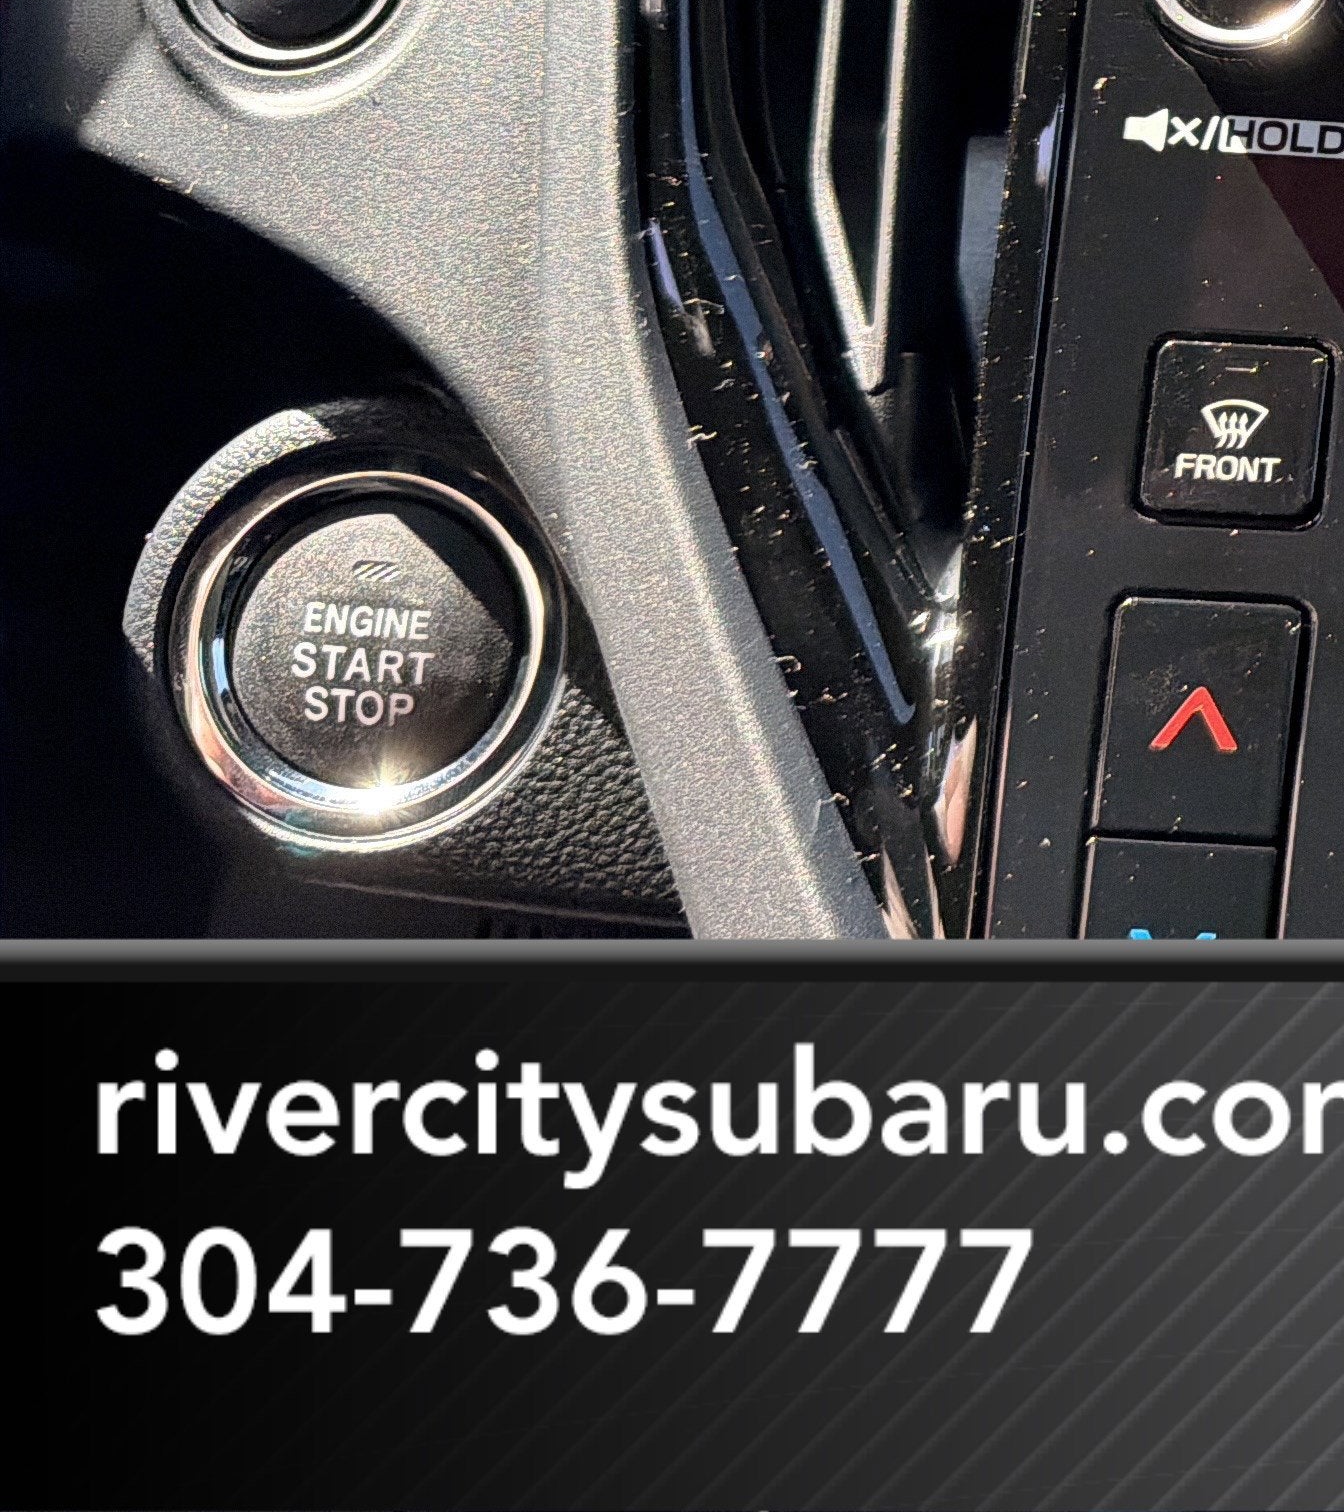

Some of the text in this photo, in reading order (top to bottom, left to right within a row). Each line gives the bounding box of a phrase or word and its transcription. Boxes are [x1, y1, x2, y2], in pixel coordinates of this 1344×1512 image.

[1174, 452, 1283, 484] FRONT
[302, 601, 432, 641] ENGINE
[290, 641, 436, 686] START
[304, 685, 416, 727] STOP
